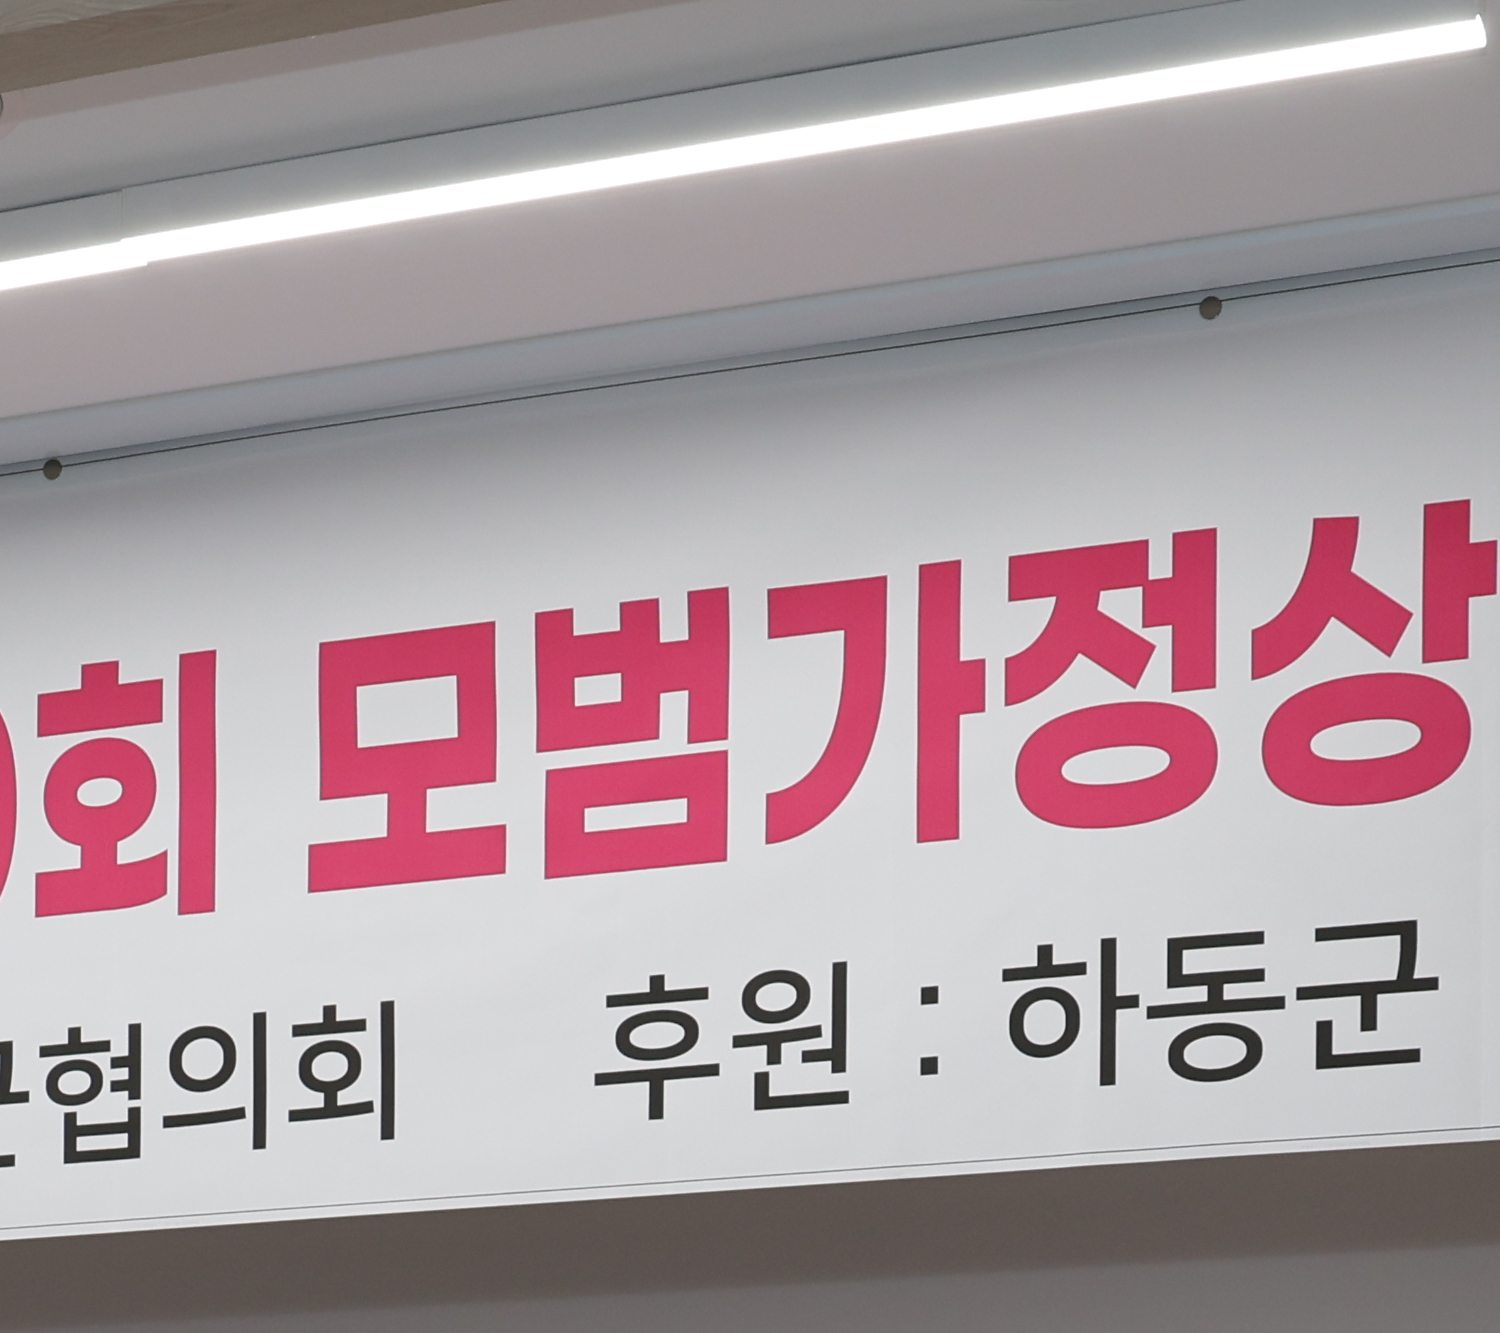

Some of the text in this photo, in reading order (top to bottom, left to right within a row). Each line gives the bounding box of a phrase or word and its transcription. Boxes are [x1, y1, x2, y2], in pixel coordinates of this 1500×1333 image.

[308, 499, 1498, 895] 모범가정상
[594, 960, 854, 1121] 후원
[1002, 919, 1439, 1087] 하동군
